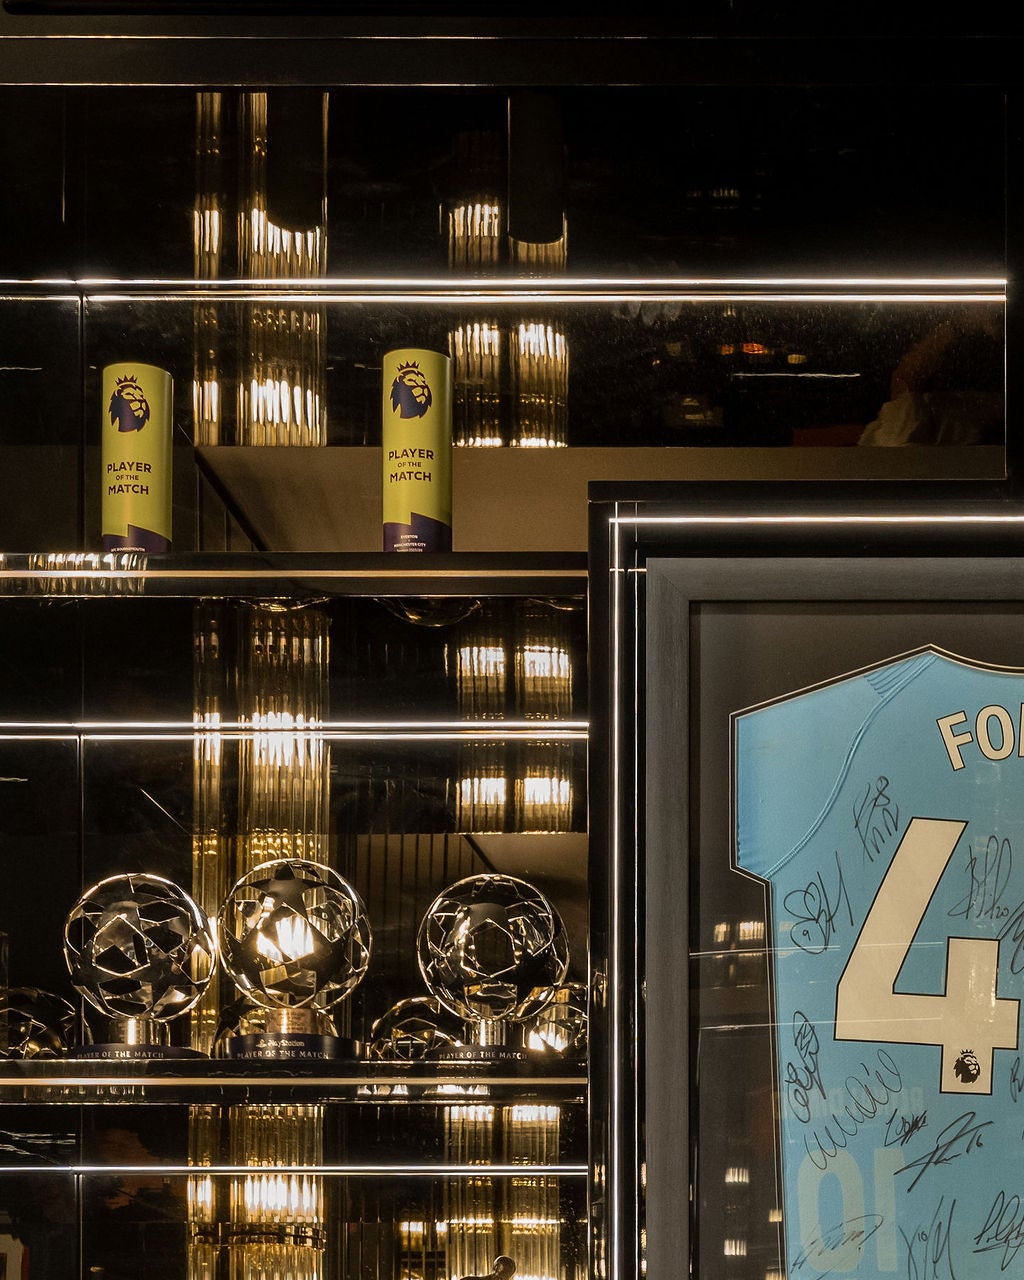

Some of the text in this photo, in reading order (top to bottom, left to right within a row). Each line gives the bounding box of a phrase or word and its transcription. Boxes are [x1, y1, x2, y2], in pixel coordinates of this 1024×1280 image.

[389, 448, 434, 460] PLAYER
[107, 461, 152, 474] PLAYER
[390, 471, 431, 483] MATCH
[108, 484, 149, 495] MATCH
[134, 1051, 164, 1059] MATCH
[237, 1051, 262, 1059] PLAYER
[300, 1051, 329, 1059] MATCH
[500, 1052, 527, 1060] MATCH
